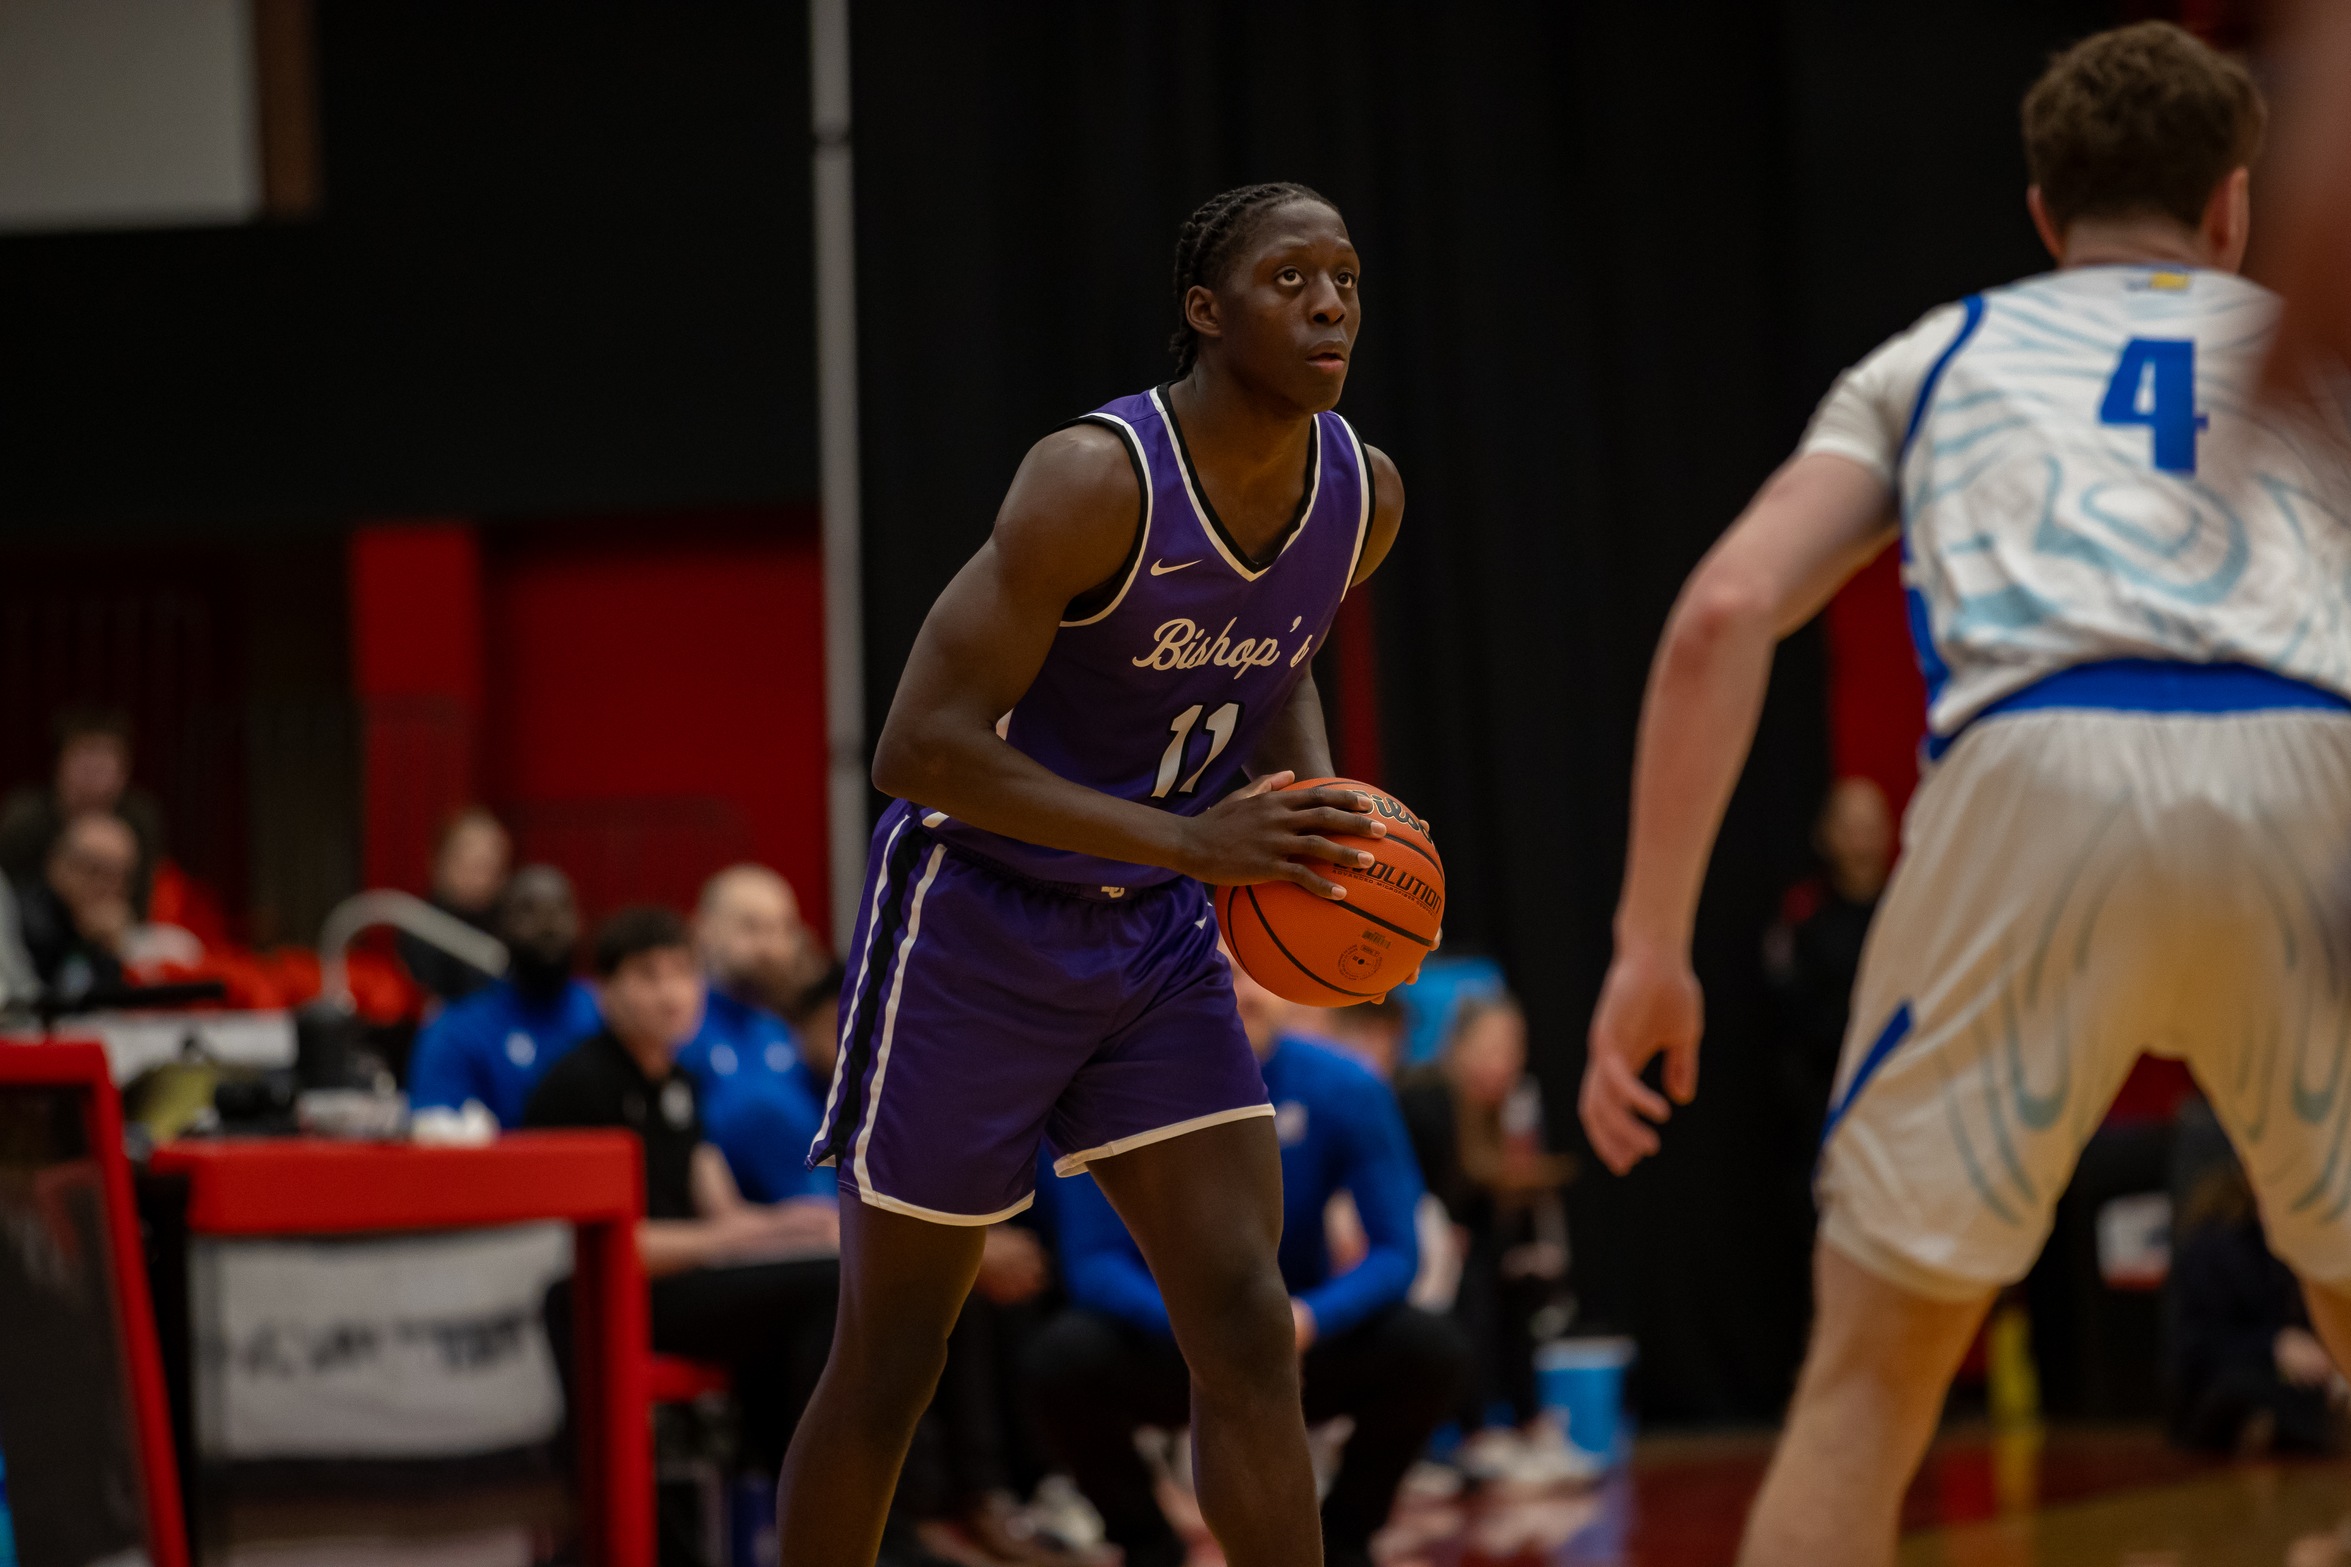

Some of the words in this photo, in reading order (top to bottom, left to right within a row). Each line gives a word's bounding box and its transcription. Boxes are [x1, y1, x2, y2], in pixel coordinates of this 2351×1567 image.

[2097, 336, 2210, 478] 4
[1131, 615, 1313, 680] Bishop's
[1150, 702, 1242, 799] 11
[1333, 860, 1442, 915] OLUTION
